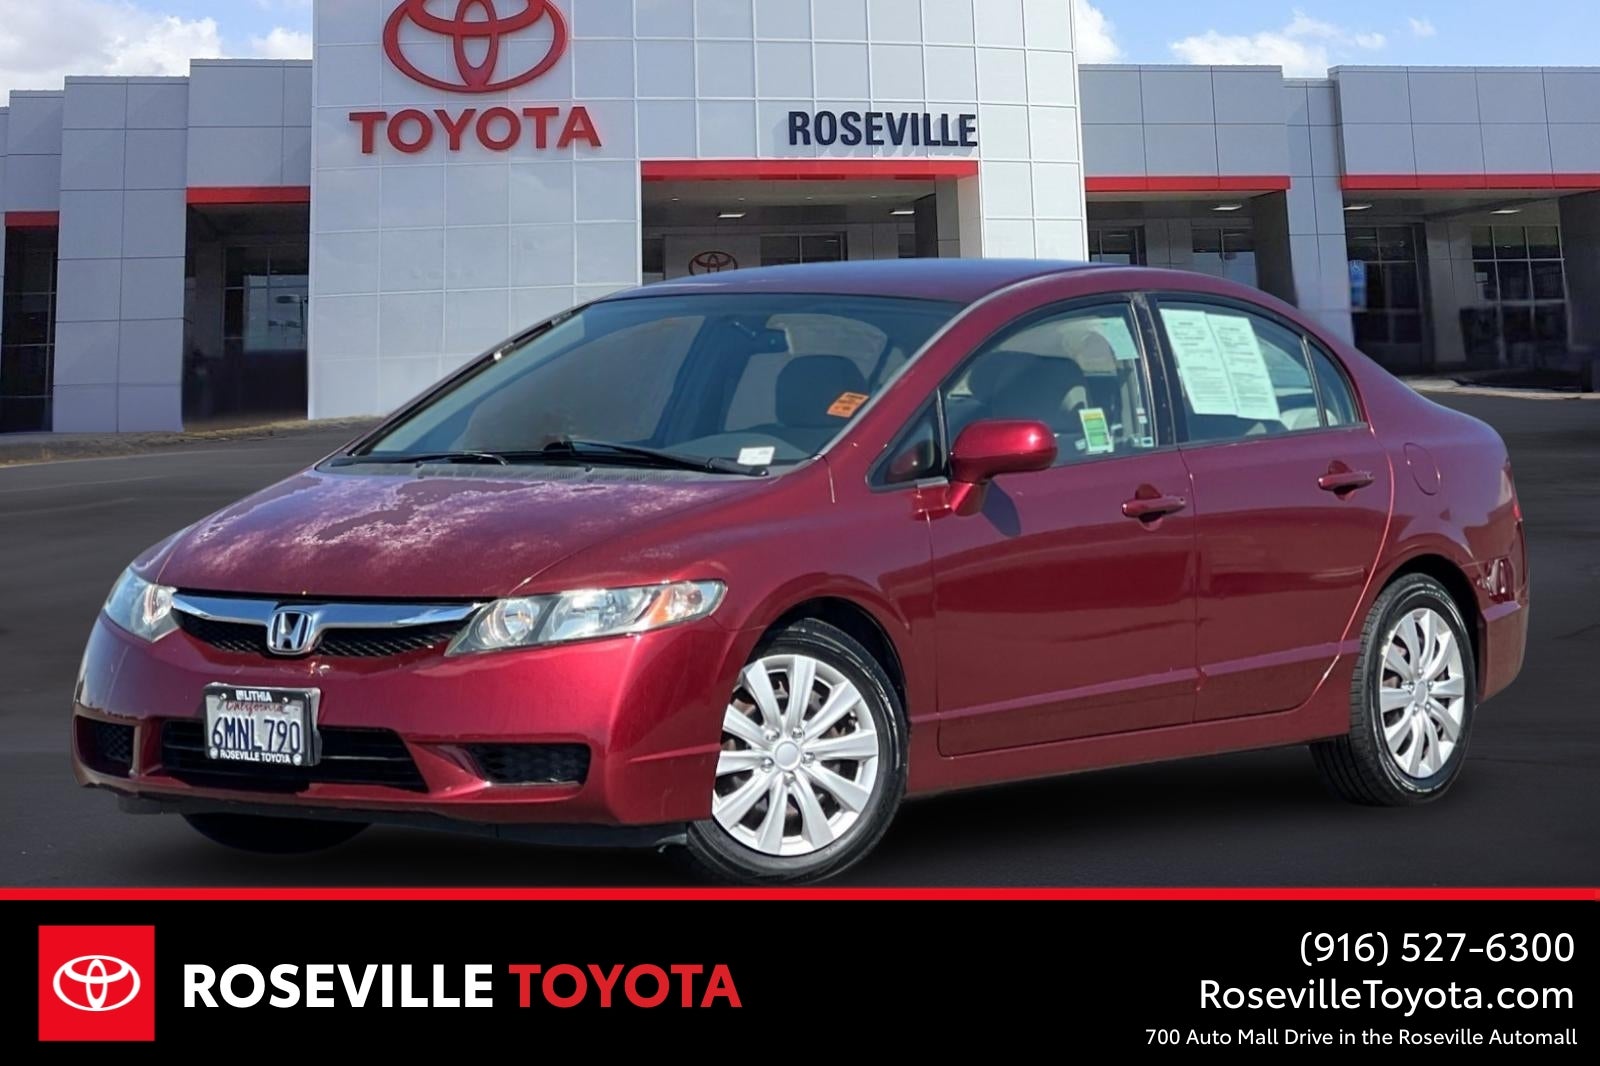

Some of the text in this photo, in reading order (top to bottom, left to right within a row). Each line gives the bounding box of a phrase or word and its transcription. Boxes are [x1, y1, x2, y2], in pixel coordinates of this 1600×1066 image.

[349, 105, 602, 154] TOYOTA
[788, 110, 978, 148] ROSEVILLE
[244, 690, 272, 702] LITHIA
[220, 749, 292, 764] ROSEVILLE TOYOTA
